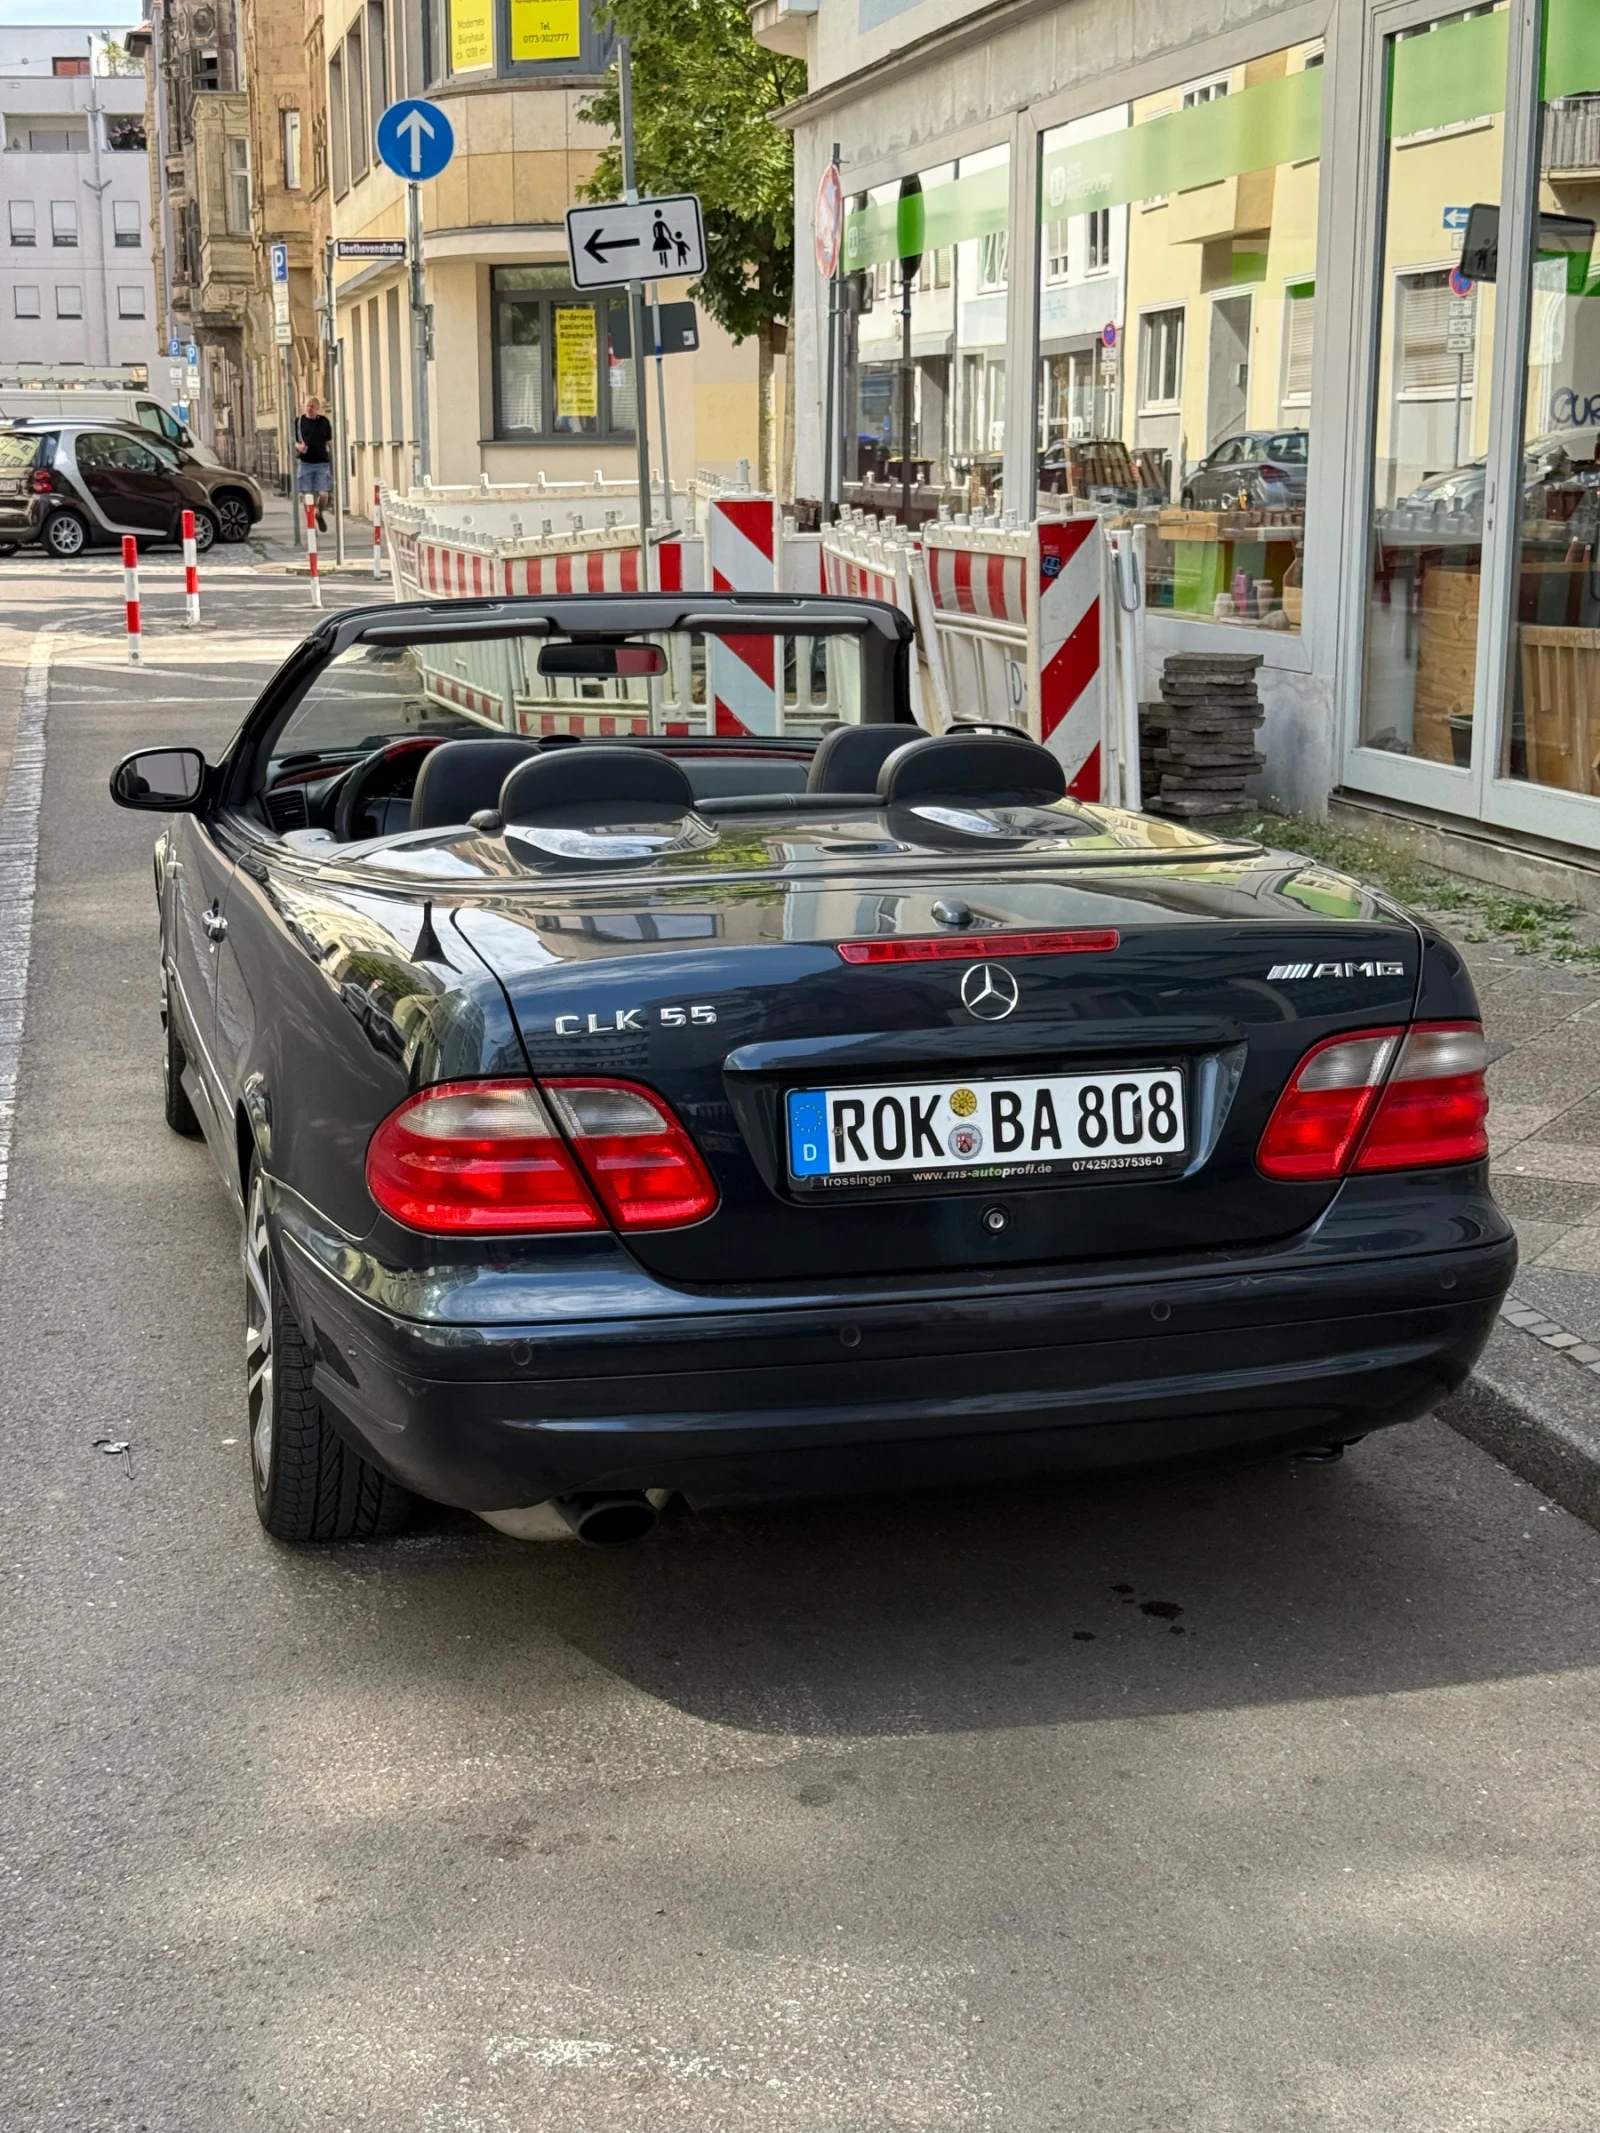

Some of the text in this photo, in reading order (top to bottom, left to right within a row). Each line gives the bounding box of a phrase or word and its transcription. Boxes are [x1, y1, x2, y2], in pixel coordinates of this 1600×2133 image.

[540, 22, 551, 31] Tel.
[340, 243, 404, 254] Beethovenstraße
[275, 250, 284, 278] P
[1312, 961, 1404, 979] AMG
[554, 1005, 718, 1036] CLK 55
[832, 1080, 1178, 1163] ROK BA 808
[803, 1143, 817, 1162] D
[822, 1155, 1163, 1188] Trossingen www.ms-autoprofi.de 07425/337536-0
